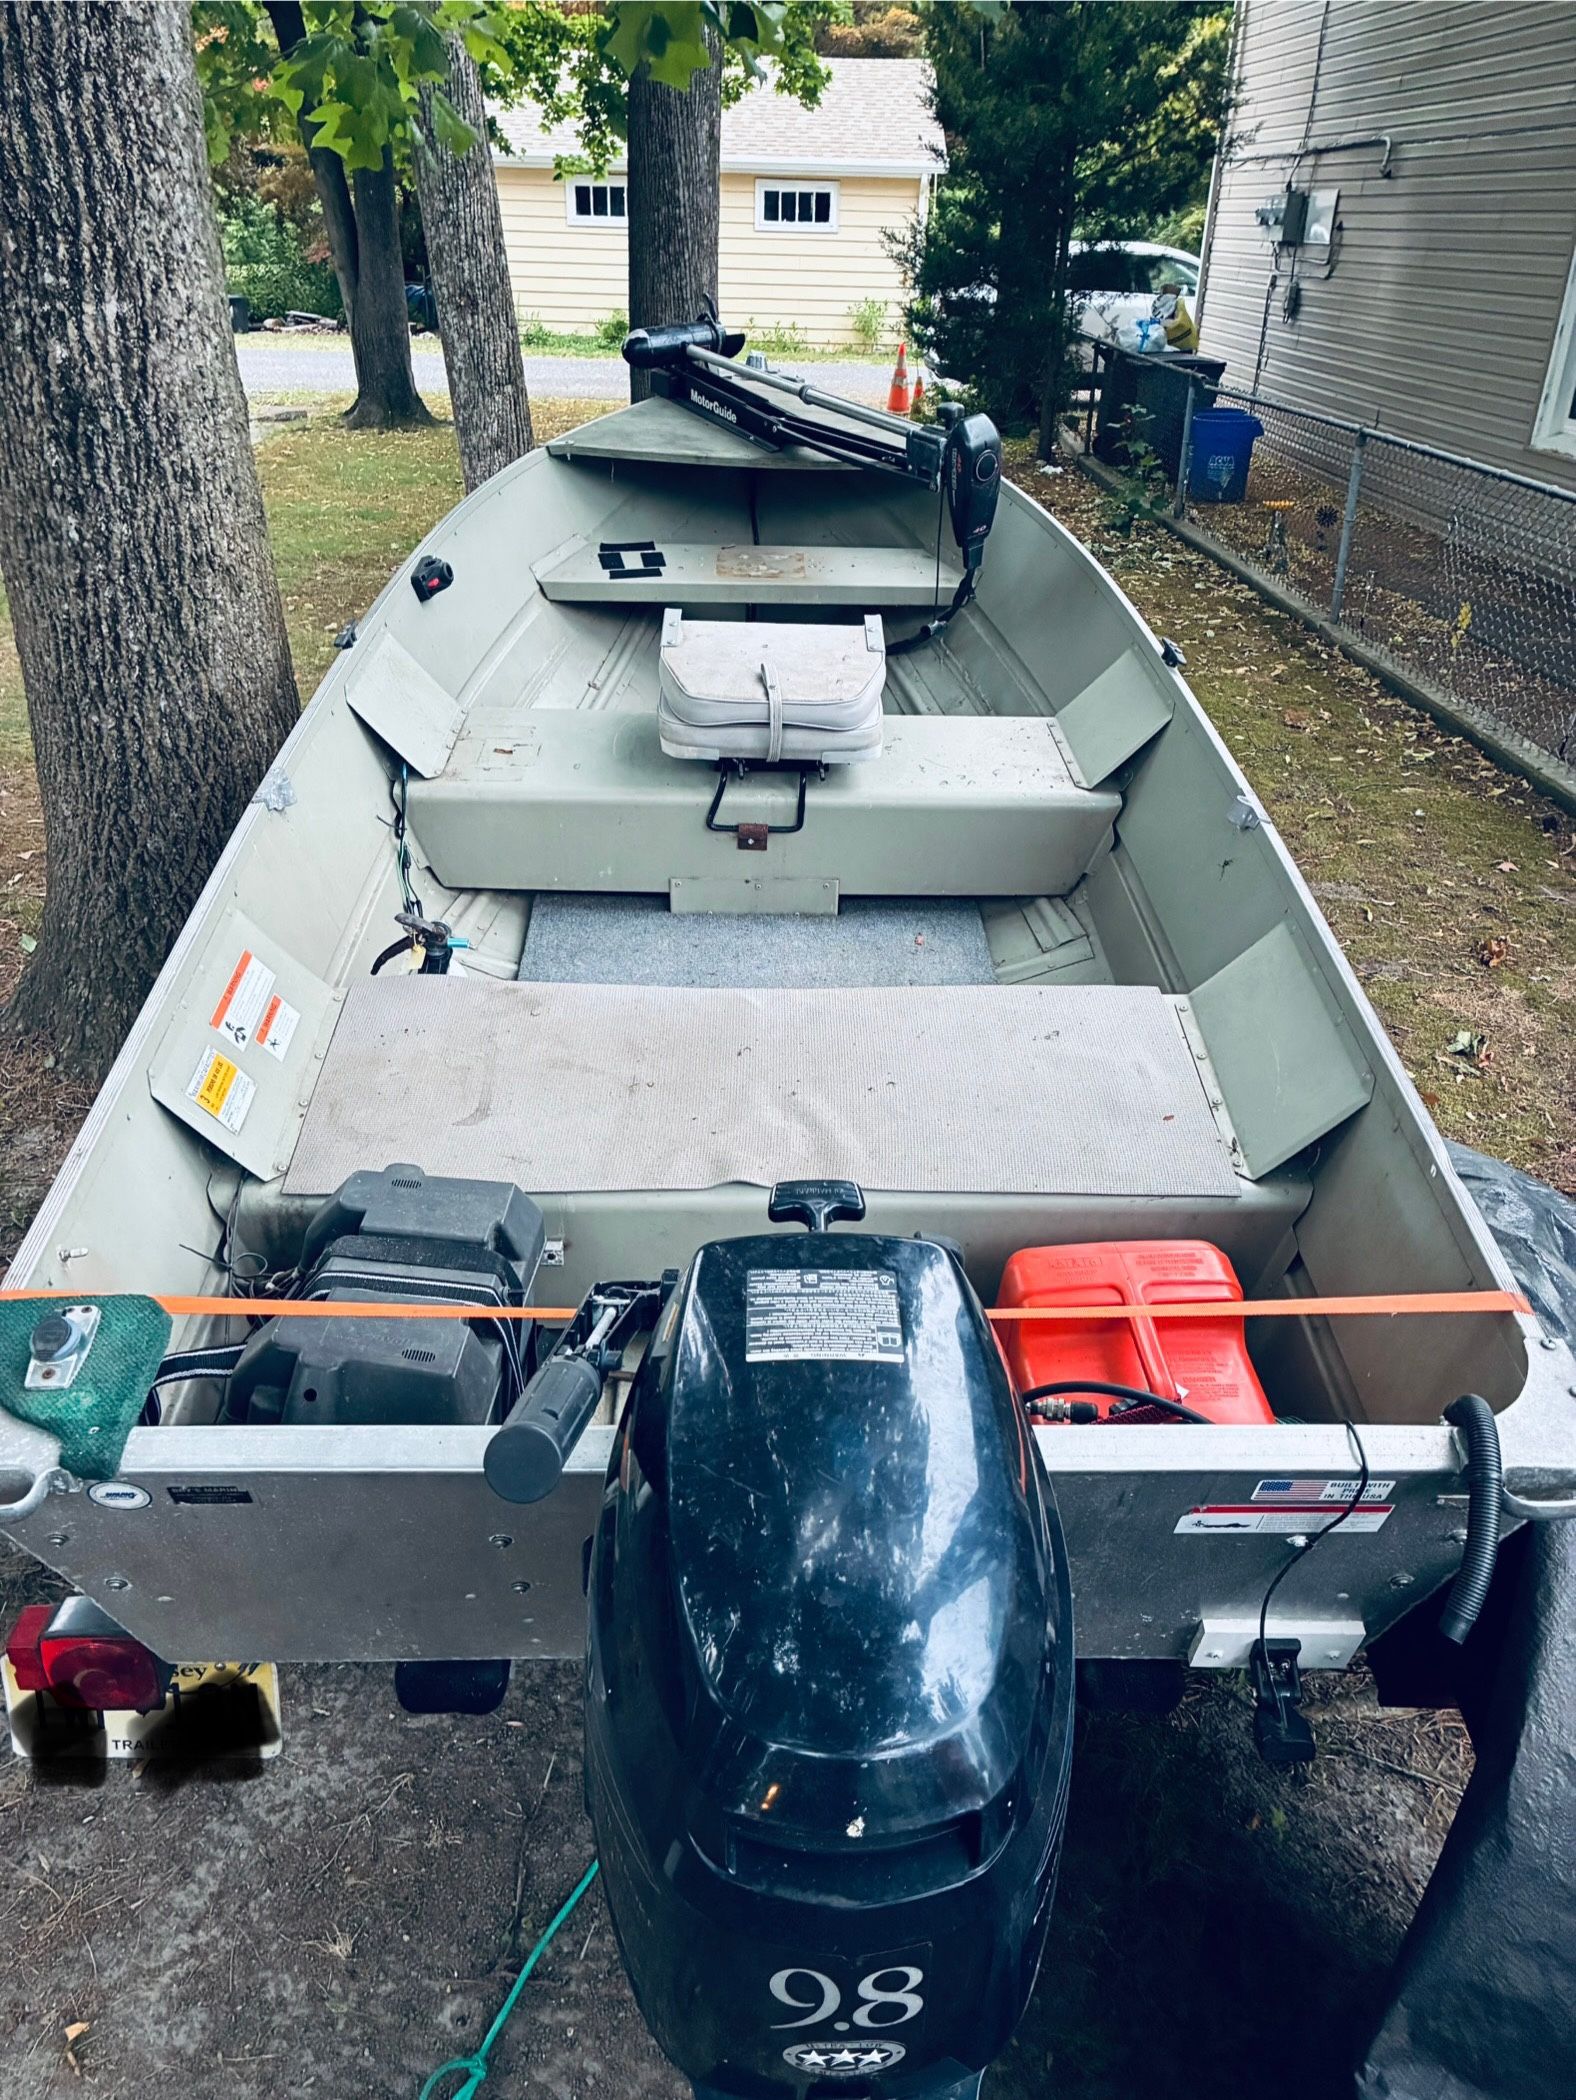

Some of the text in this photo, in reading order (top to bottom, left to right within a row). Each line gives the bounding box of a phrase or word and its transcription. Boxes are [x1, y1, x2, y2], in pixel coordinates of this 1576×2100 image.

[690, 388, 737, 424] MotorGuide
[112, 1739, 167, 1751] TRAIL
[769, 1966, 924, 2032] 9.8
